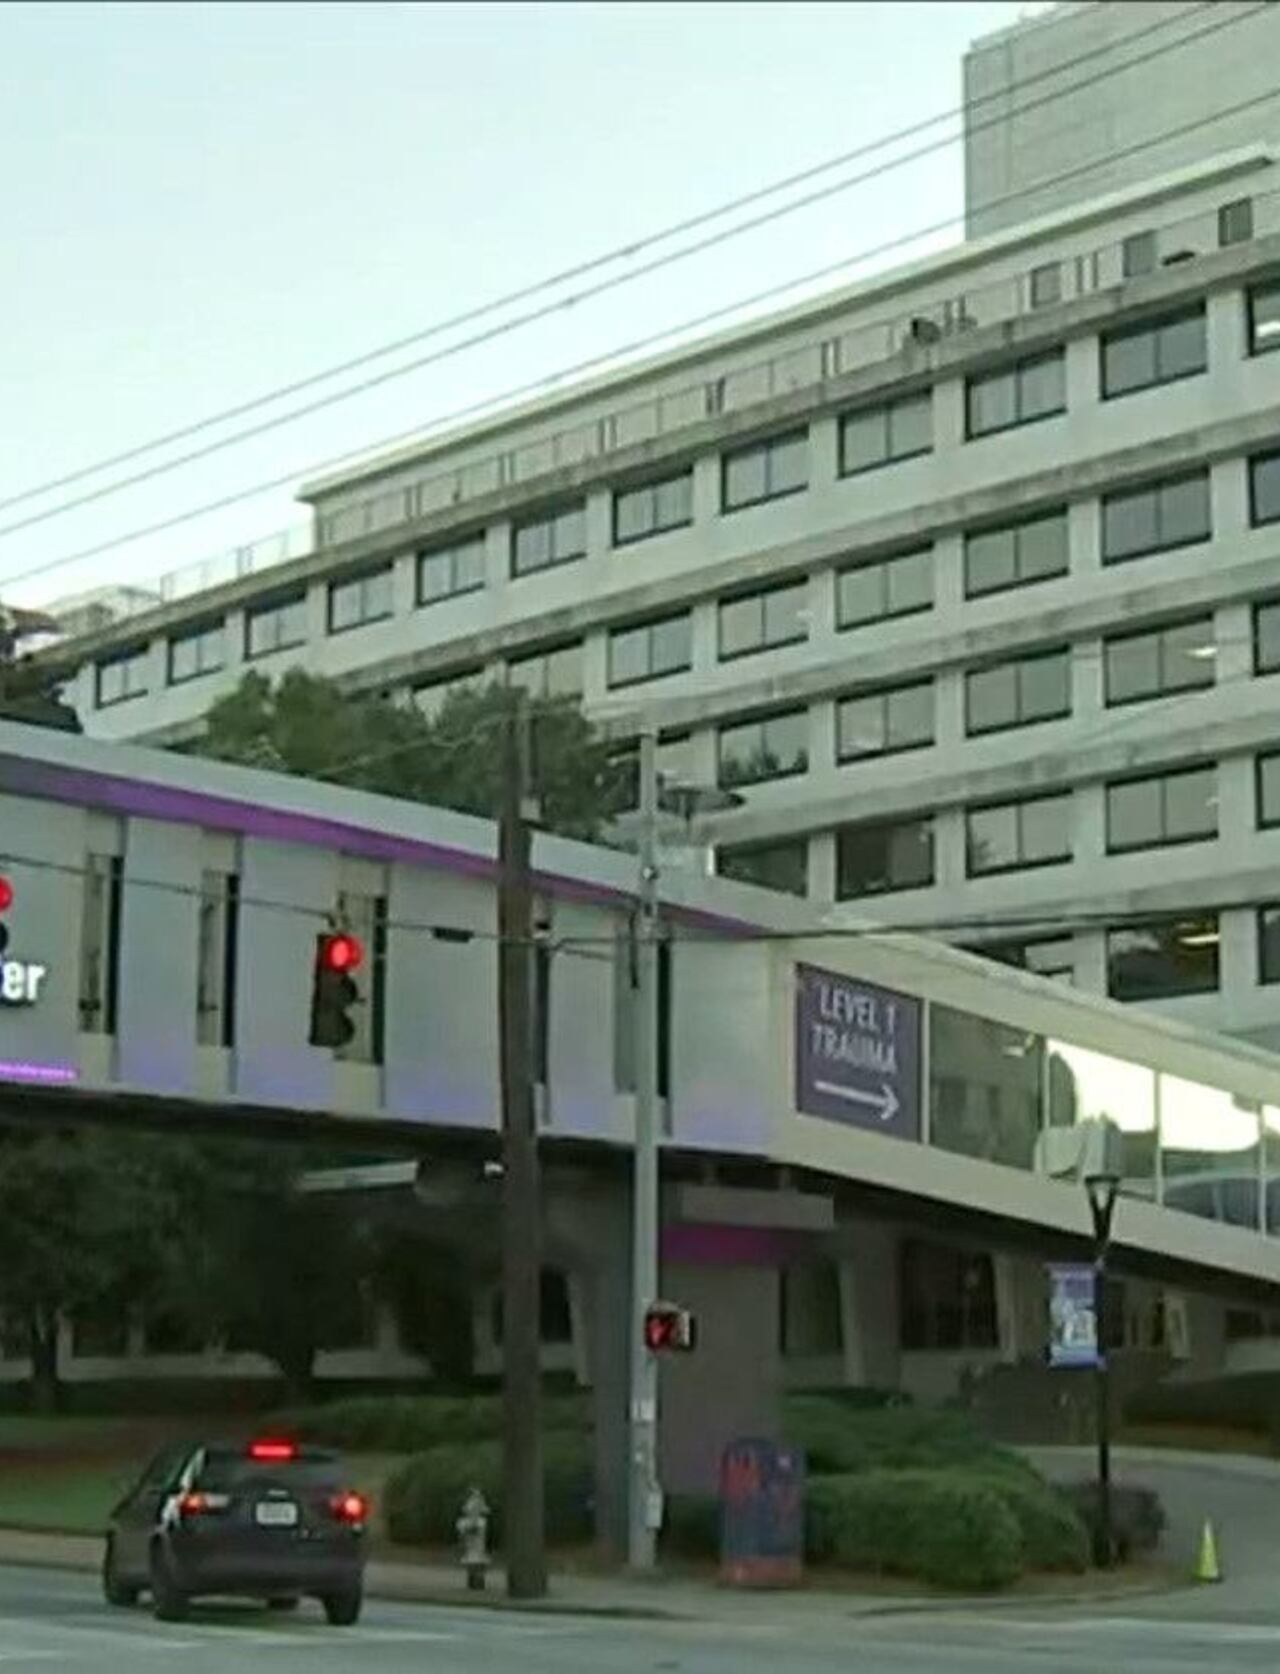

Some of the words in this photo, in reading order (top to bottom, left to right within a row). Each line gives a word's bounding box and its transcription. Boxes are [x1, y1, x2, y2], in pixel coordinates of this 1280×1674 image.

[821, 983, 879, 1031] LEVEL
[887, 1004, 896, 1035] 1
[812, 1022, 898, 1074] TRAUMA
